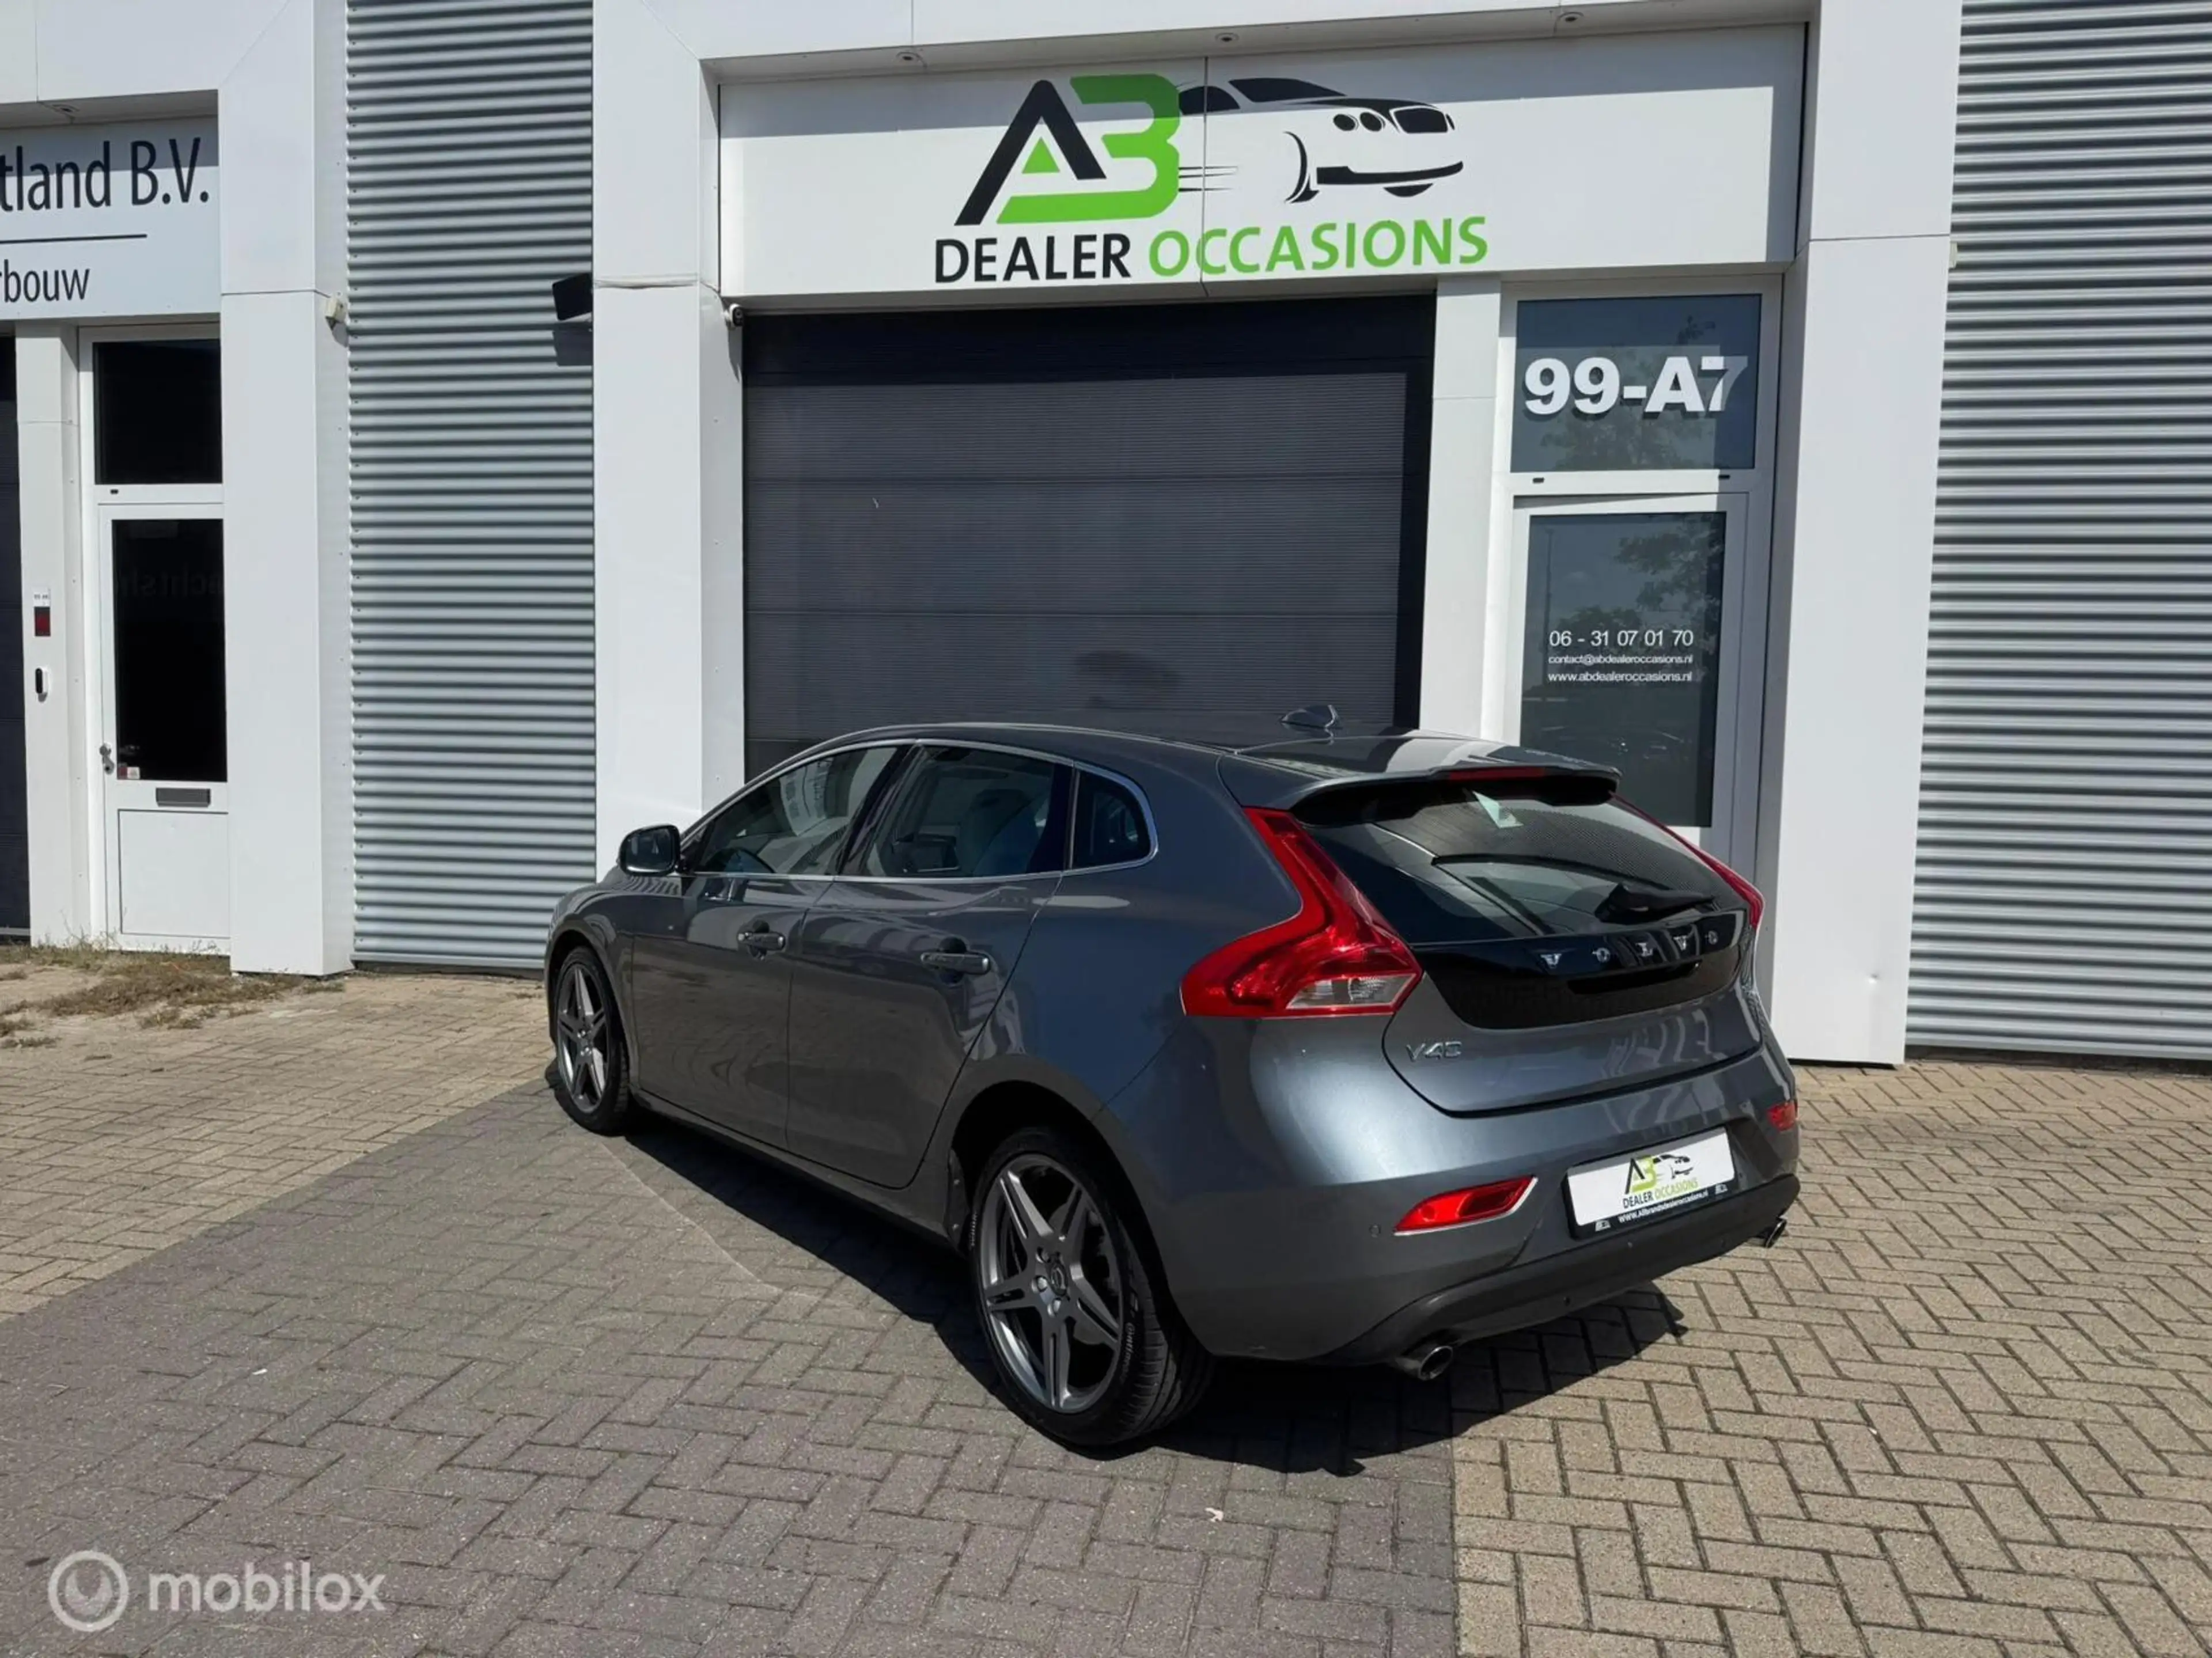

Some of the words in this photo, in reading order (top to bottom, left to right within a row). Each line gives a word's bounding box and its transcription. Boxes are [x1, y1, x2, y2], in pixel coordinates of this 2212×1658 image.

[131, 137, 209, 206] B.V.
[935, 233, 1131, 284] DEALER
[1148, 216, 1487, 278] OCCASIONS
[1524, 355, 1748, 415] 99-A7
[1549, 629, 1572, 647] 06
[1590, 629, 1609, 646] 31
[1617, 630, 1638, 646] 07
[1644, 629, 1663, 646] 01
[1672, 629, 1694, 646] 70
[1548, 654, 1693, 666] contact@abdealeroccasions.nl
[1548, 671, 1692, 682] www.abdealeroccasions.nl
[1540, 930, 1718, 968] VOLVO
[1622, 1191, 1654, 1209] DEALER
[1654, 1178, 1699, 1201] OCCASIONS
